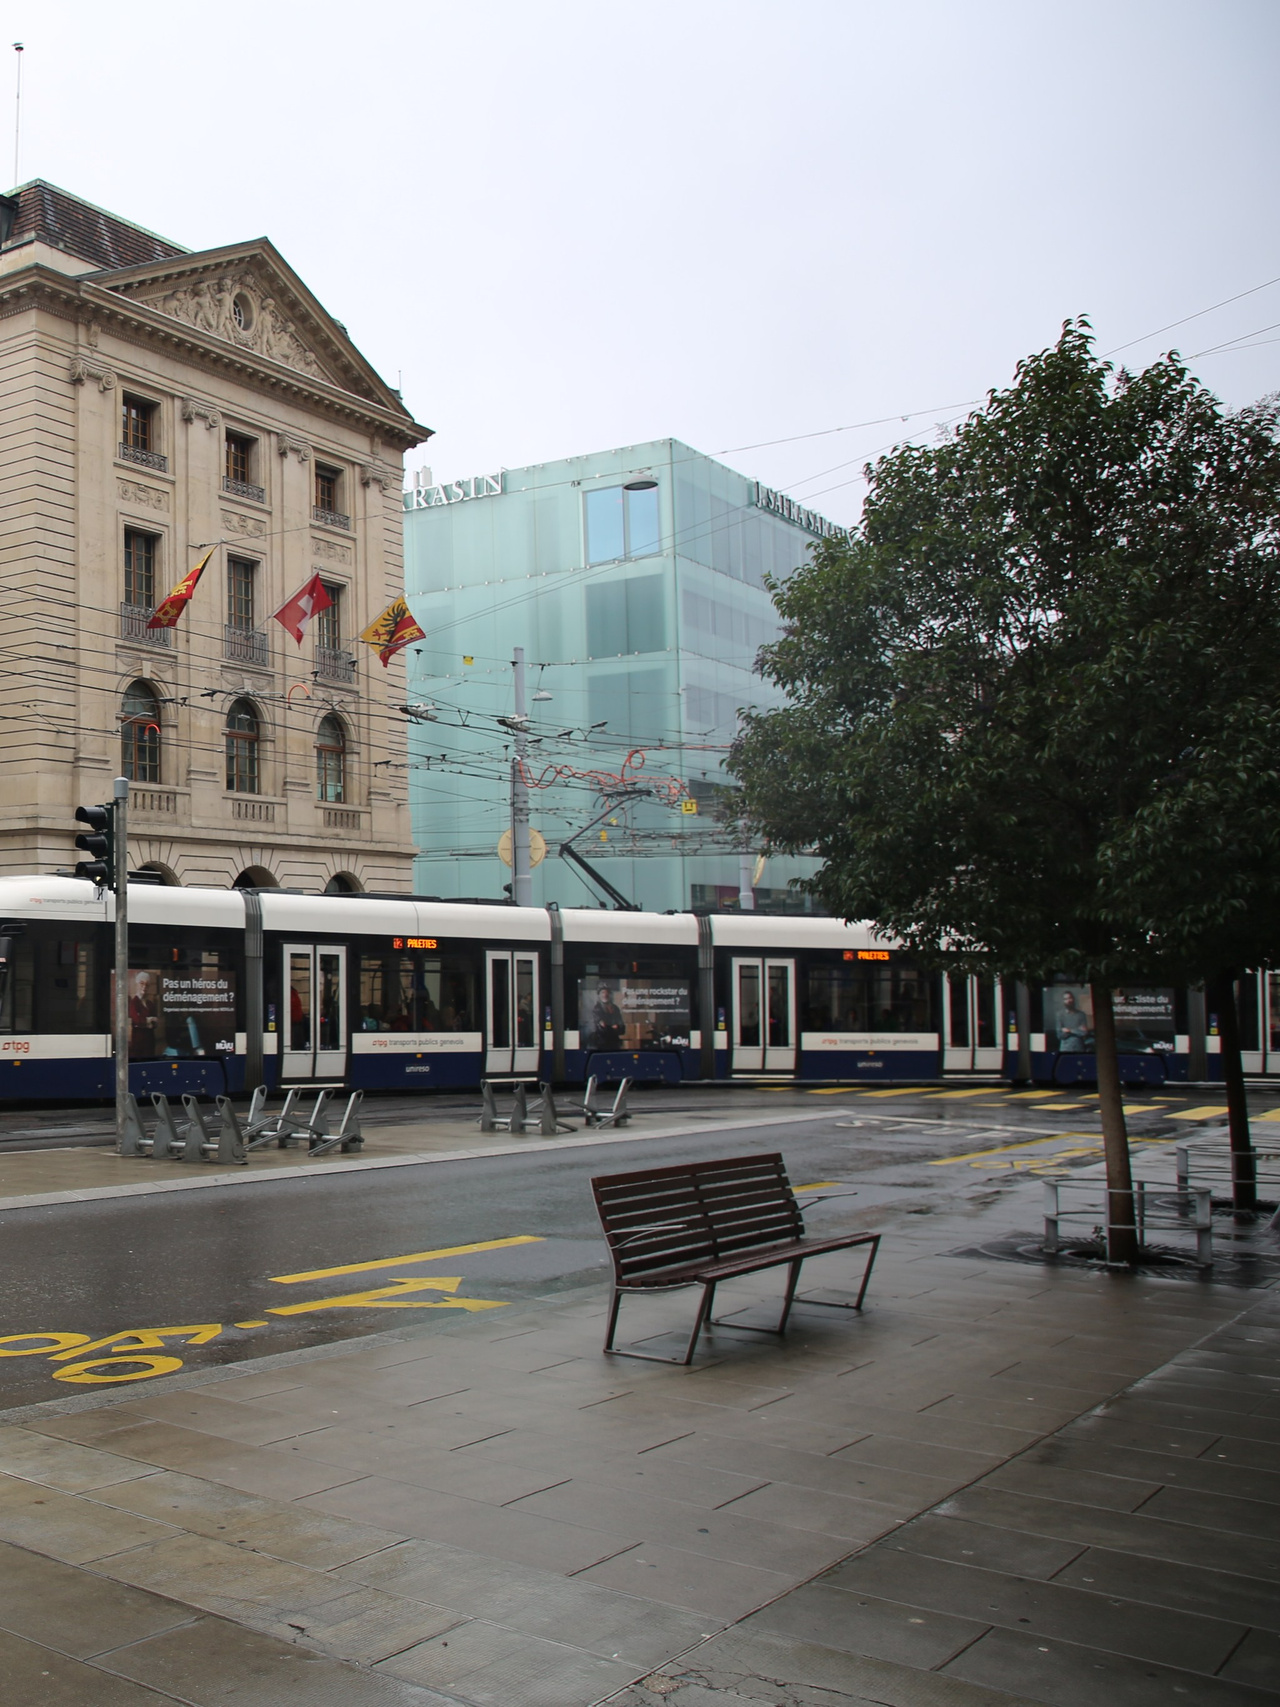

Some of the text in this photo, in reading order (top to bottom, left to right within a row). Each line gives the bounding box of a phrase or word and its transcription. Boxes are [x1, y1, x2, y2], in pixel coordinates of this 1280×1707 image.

[403, 470, 504, 511] RASIN
[407, 938, 438, 949] PALETTES
[163, 978, 228, 989] Pas un héros du
[649, 987, 677, 995] rockstar
[678, 987, 688, 995] du
[163, 991, 228, 1004] déménagement
[1156, 995, 1169, 1003] du
[388, 1039, 417, 1047] transports
[418, 1038, 439, 1047] publics
[439, 1038, 464, 1047] genevois
[405, 1065, 430, 1073] unireso
